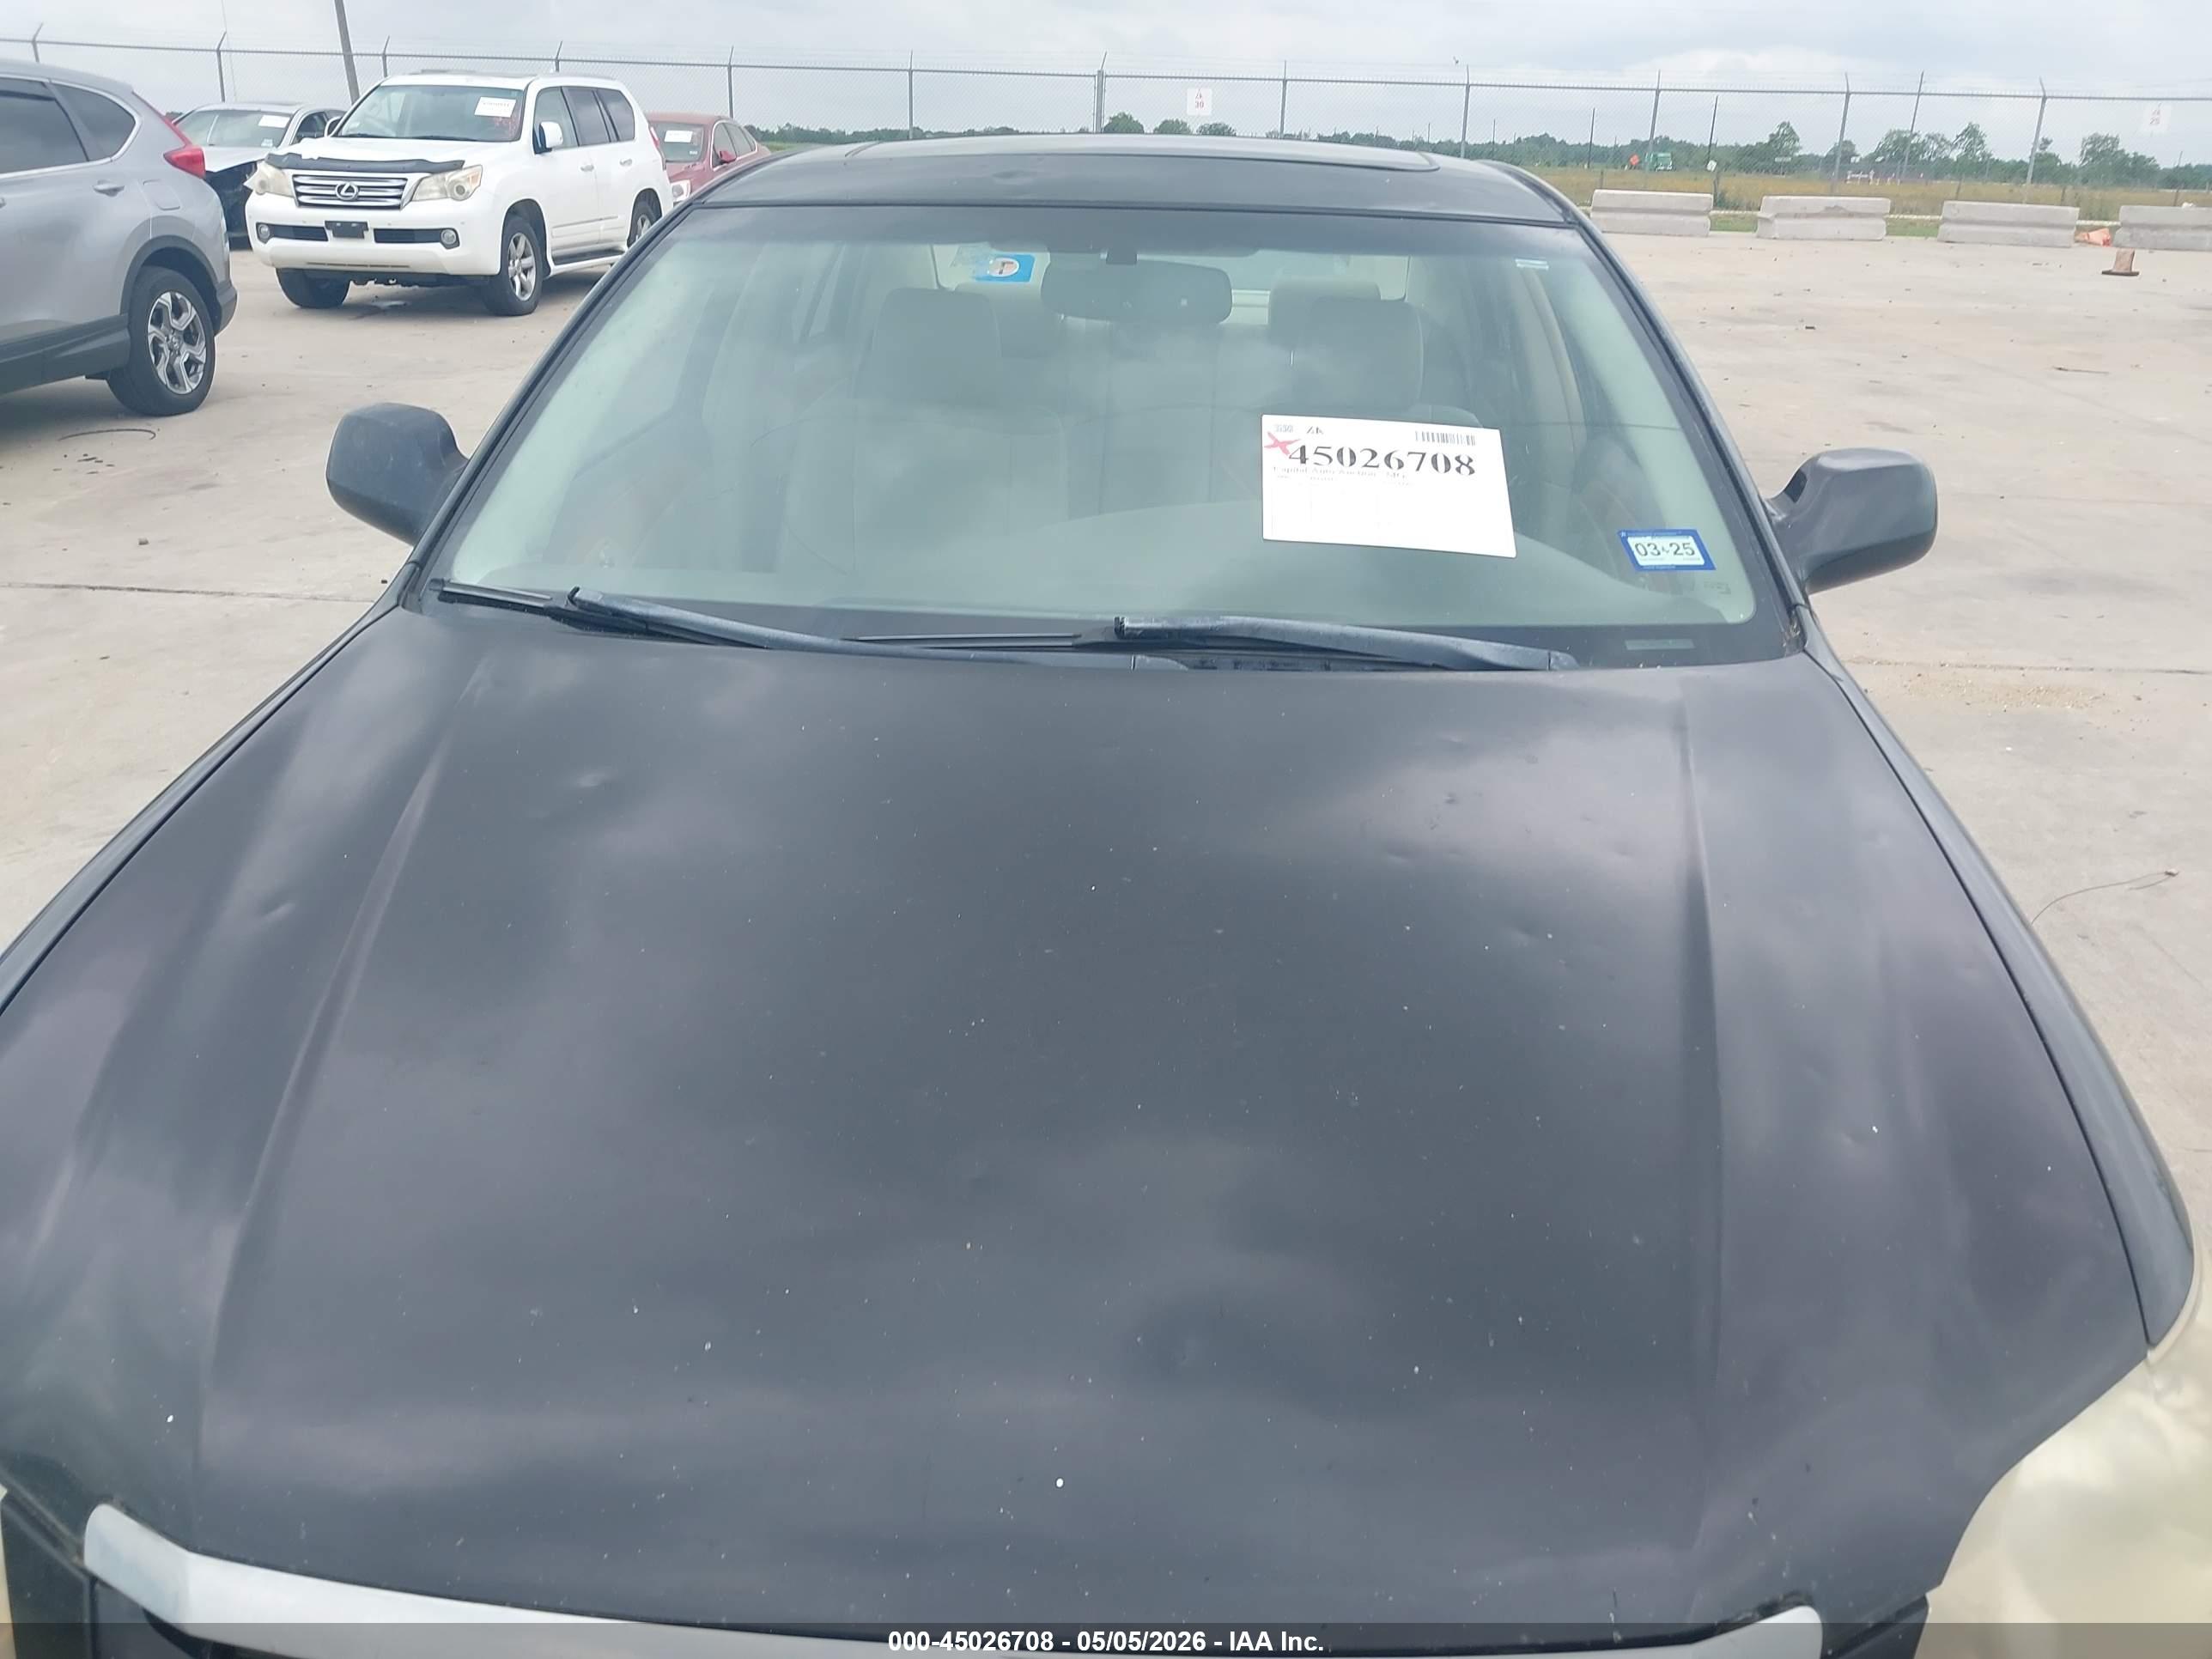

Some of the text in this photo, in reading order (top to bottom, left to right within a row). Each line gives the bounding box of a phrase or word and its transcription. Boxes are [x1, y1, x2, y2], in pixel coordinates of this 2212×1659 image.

[1289, 445, 1475, 477] 45026708
[1634, 542, 1696, 556] 03 25
